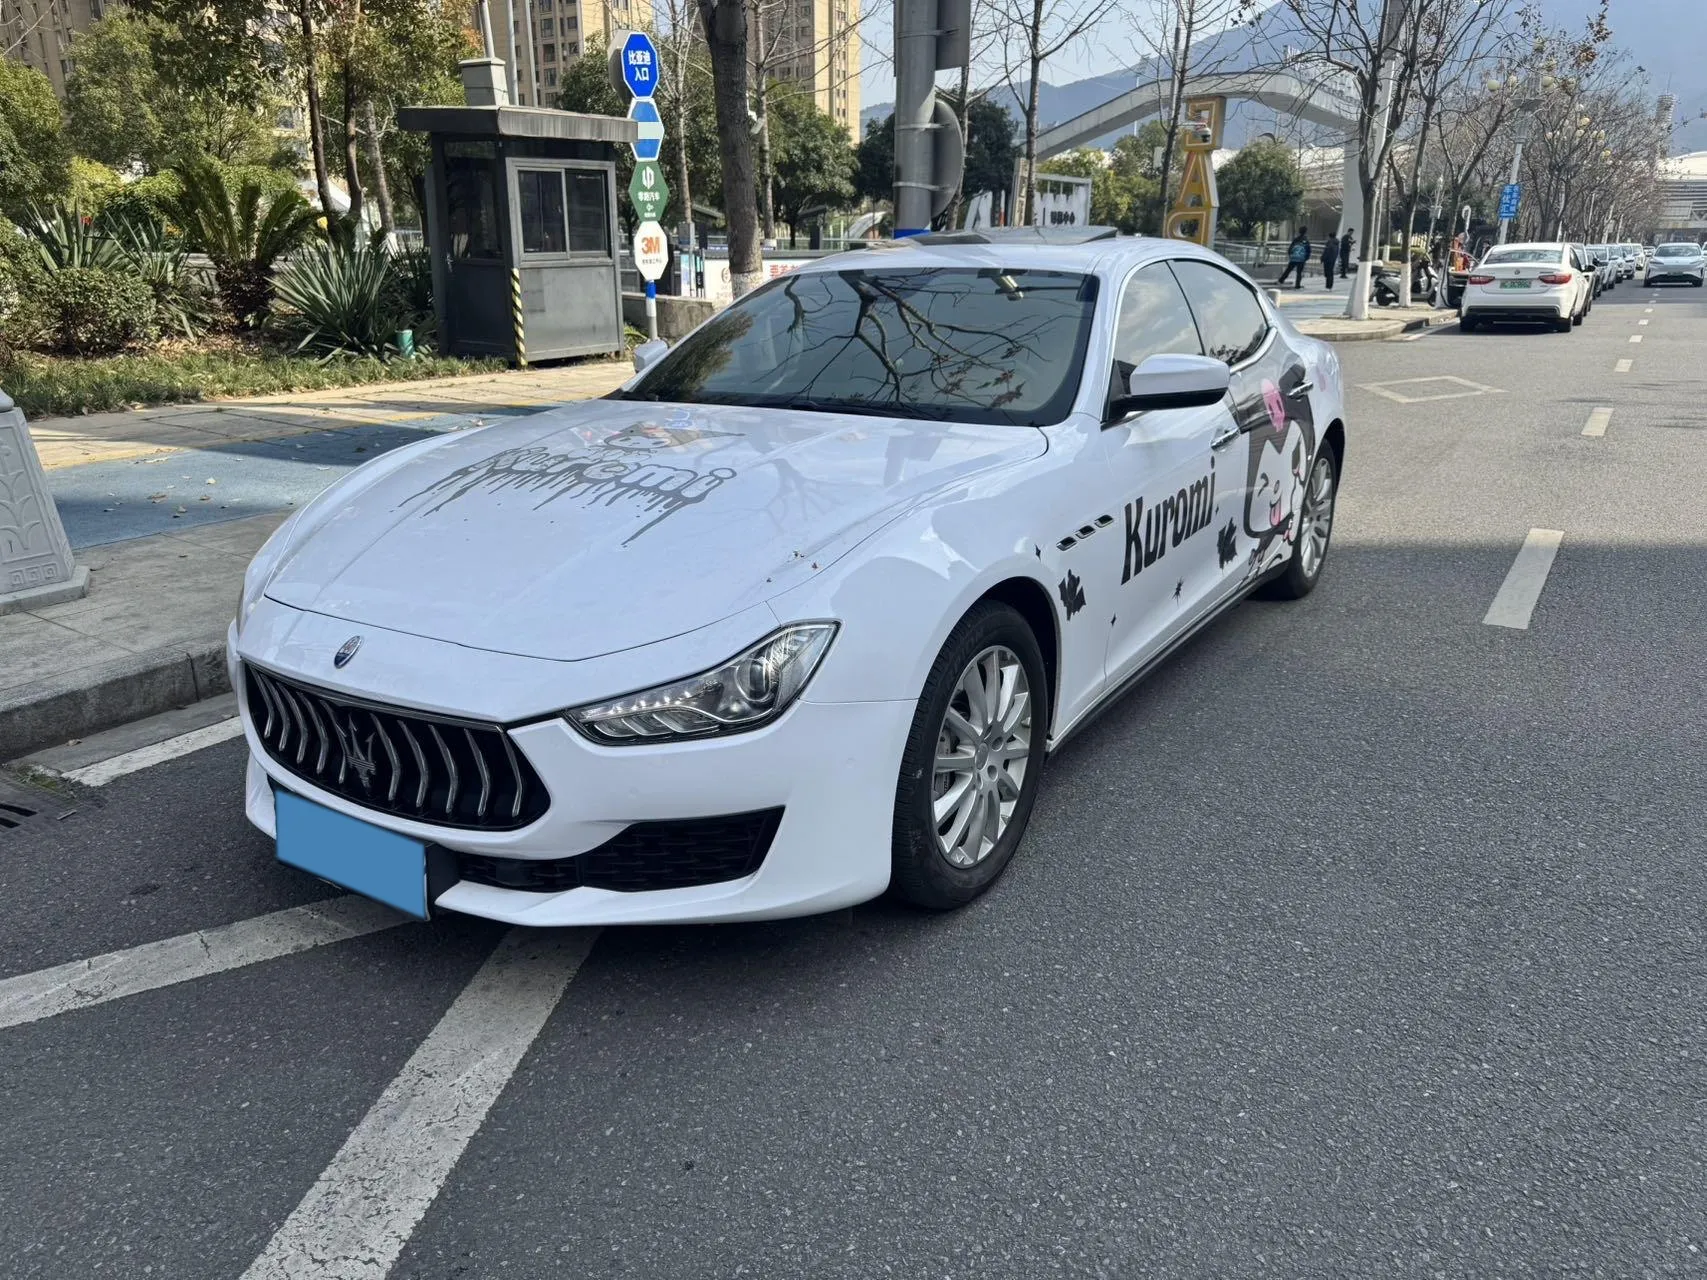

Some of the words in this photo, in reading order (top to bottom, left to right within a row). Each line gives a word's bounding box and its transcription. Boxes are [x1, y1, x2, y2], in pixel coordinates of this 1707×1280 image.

[628, 50, 652, 65] 比亚迪
[634, 67, 650, 82] 入口
[641, 237, 661, 254] 3M
[1120, 456, 1217, 586] Kuromi
